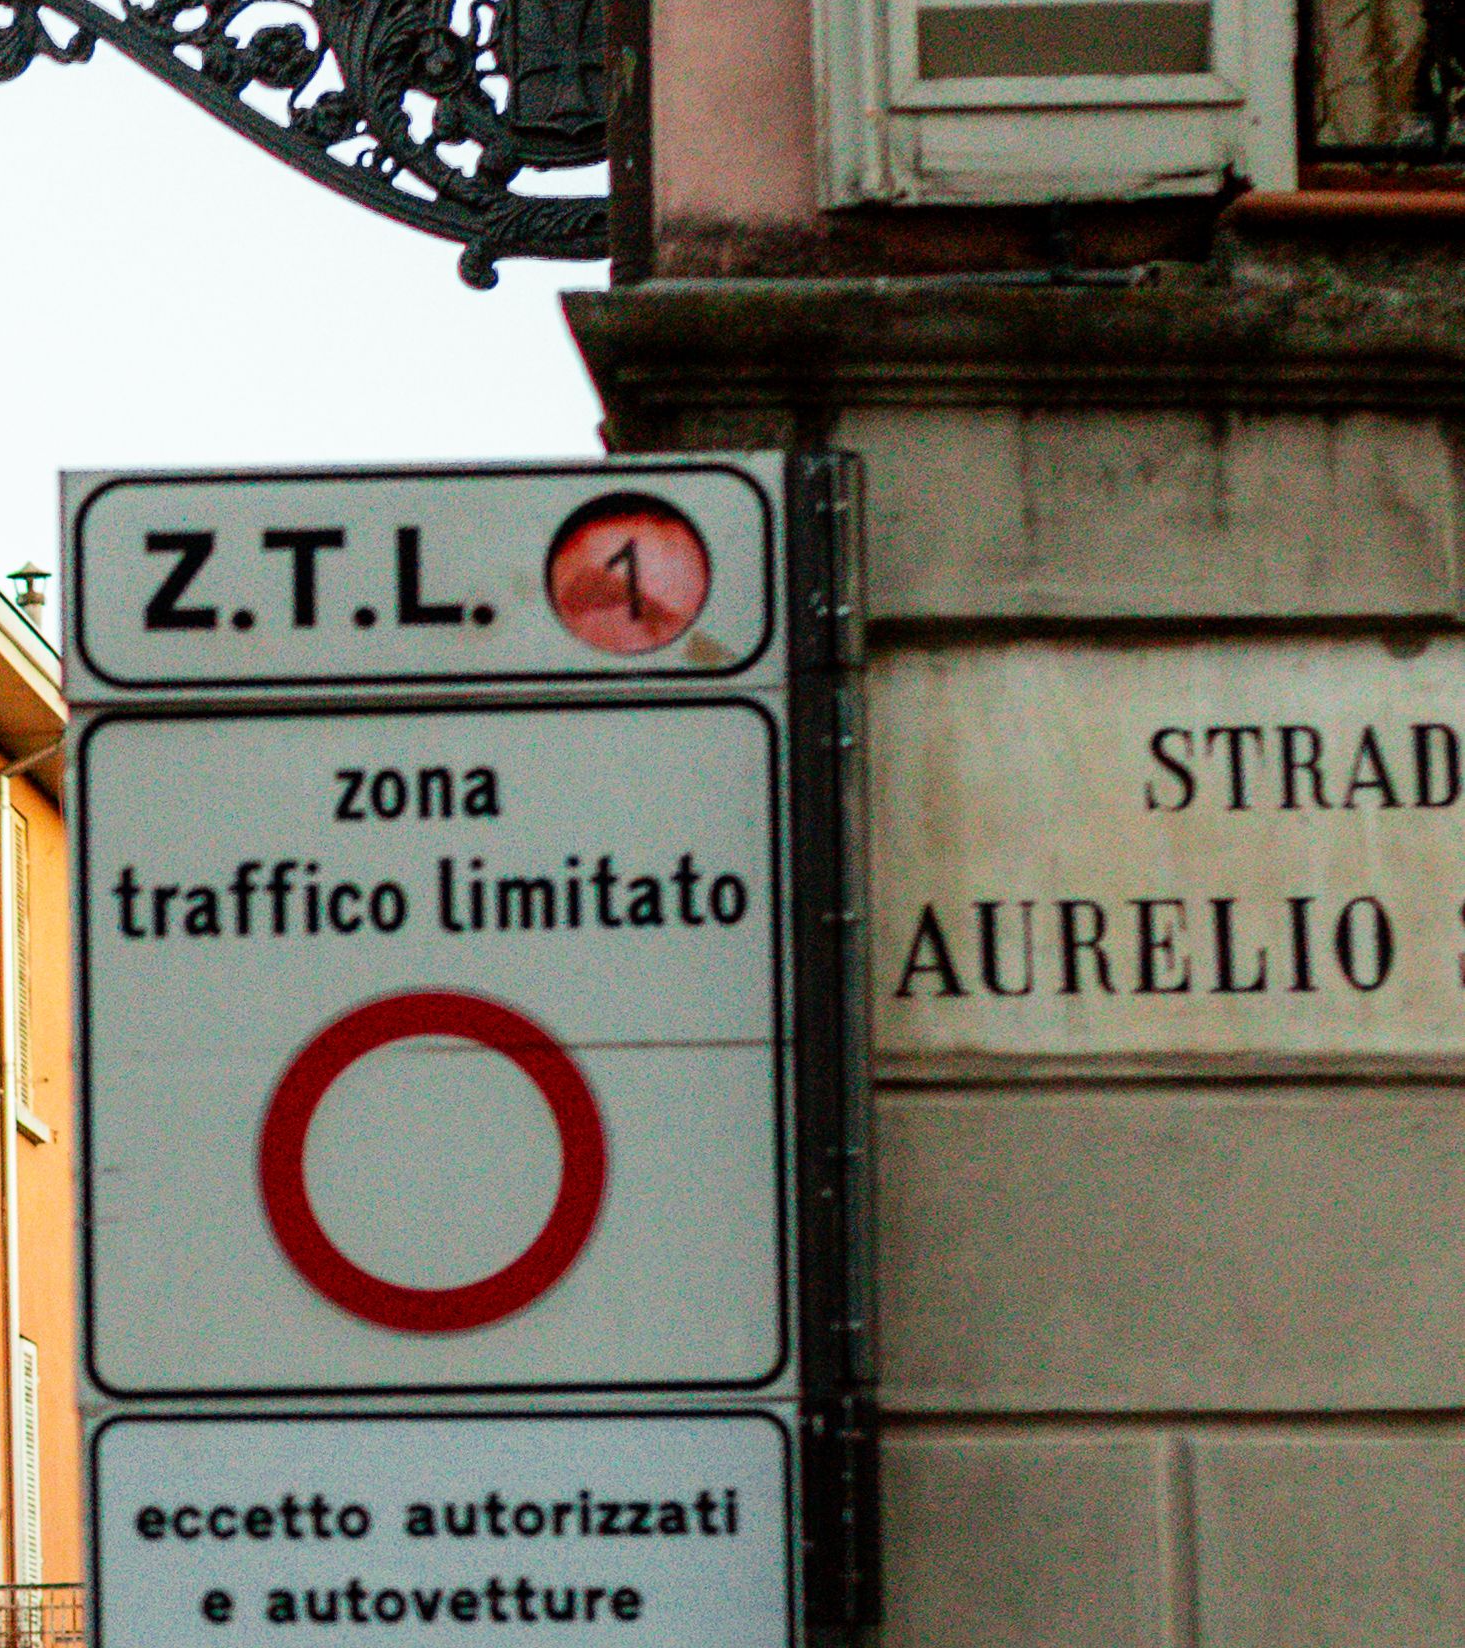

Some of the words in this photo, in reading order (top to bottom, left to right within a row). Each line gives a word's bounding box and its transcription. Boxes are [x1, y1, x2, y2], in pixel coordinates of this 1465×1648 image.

[144, 526, 496, 632] Z.T.L.
[334, 765, 502, 822] zona
[1146, 722, 1465, 812] STRAD
[113, 859, 408, 940] traffico
[437, 854, 749, 935] limitato
[891, 894, 1397, 1002] AURELIO
[134, 1493, 372, 1541] eccetto
[405, 1487, 739, 1538] autorizzati
[201, 1589, 235, 1625] e
[266, 1577, 644, 1625] autovetture
